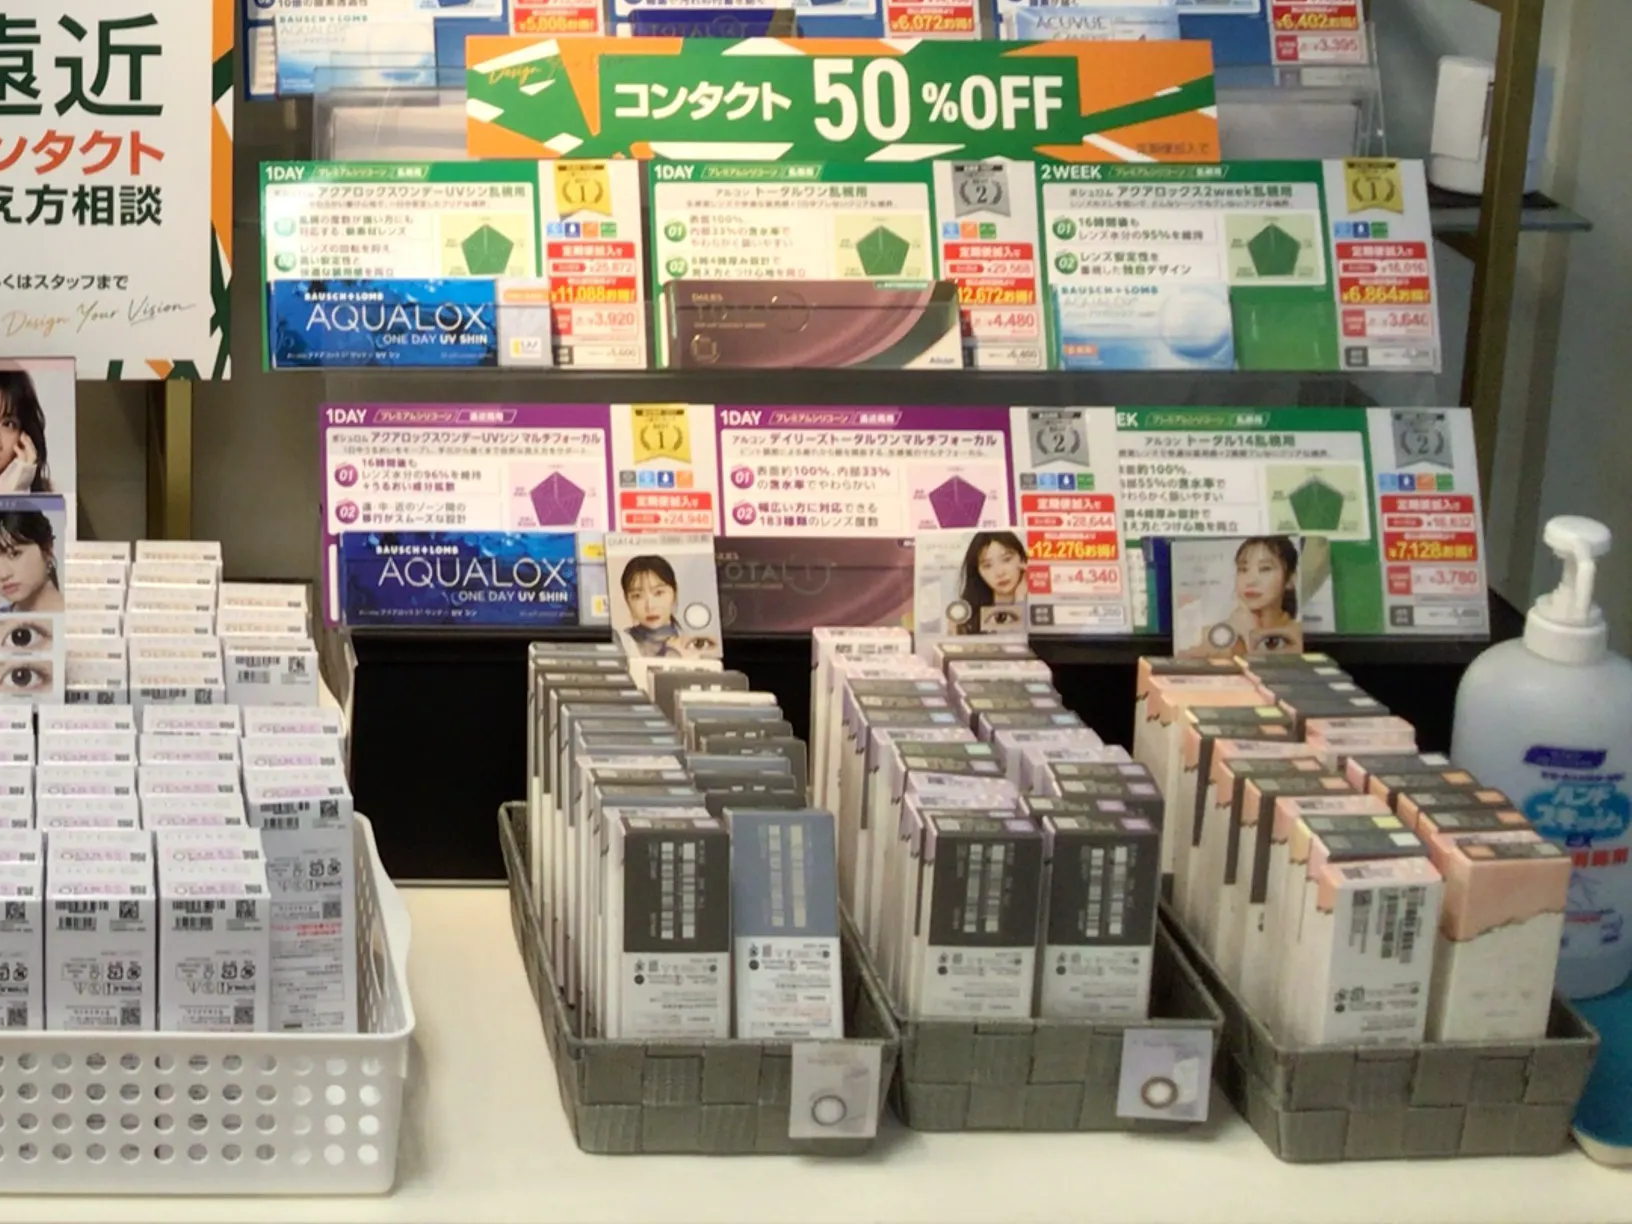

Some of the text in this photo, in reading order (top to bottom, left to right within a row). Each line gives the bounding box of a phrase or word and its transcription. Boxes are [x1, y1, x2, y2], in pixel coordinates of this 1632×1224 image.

[614, 82, 793, 121] コンタクト
[265, 166, 306, 181] 1DAY
[654, 165, 695, 180] 1DAY
[1040, 164, 1103, 180] 2WEEK
[1, 296, 198, 338] Design Your Vision
[305, 302, 489, 332] AQUALOX
[383, 333, 489, 345] ONE DAY UV SHIN
[325, 408, 368, 424] 1DAY
[719, 410, 763, 426] 1DAY
[378, 557, 570, 589] AQUALOX
[459, 590, 569, 604] ONE DAY UV SHIN
